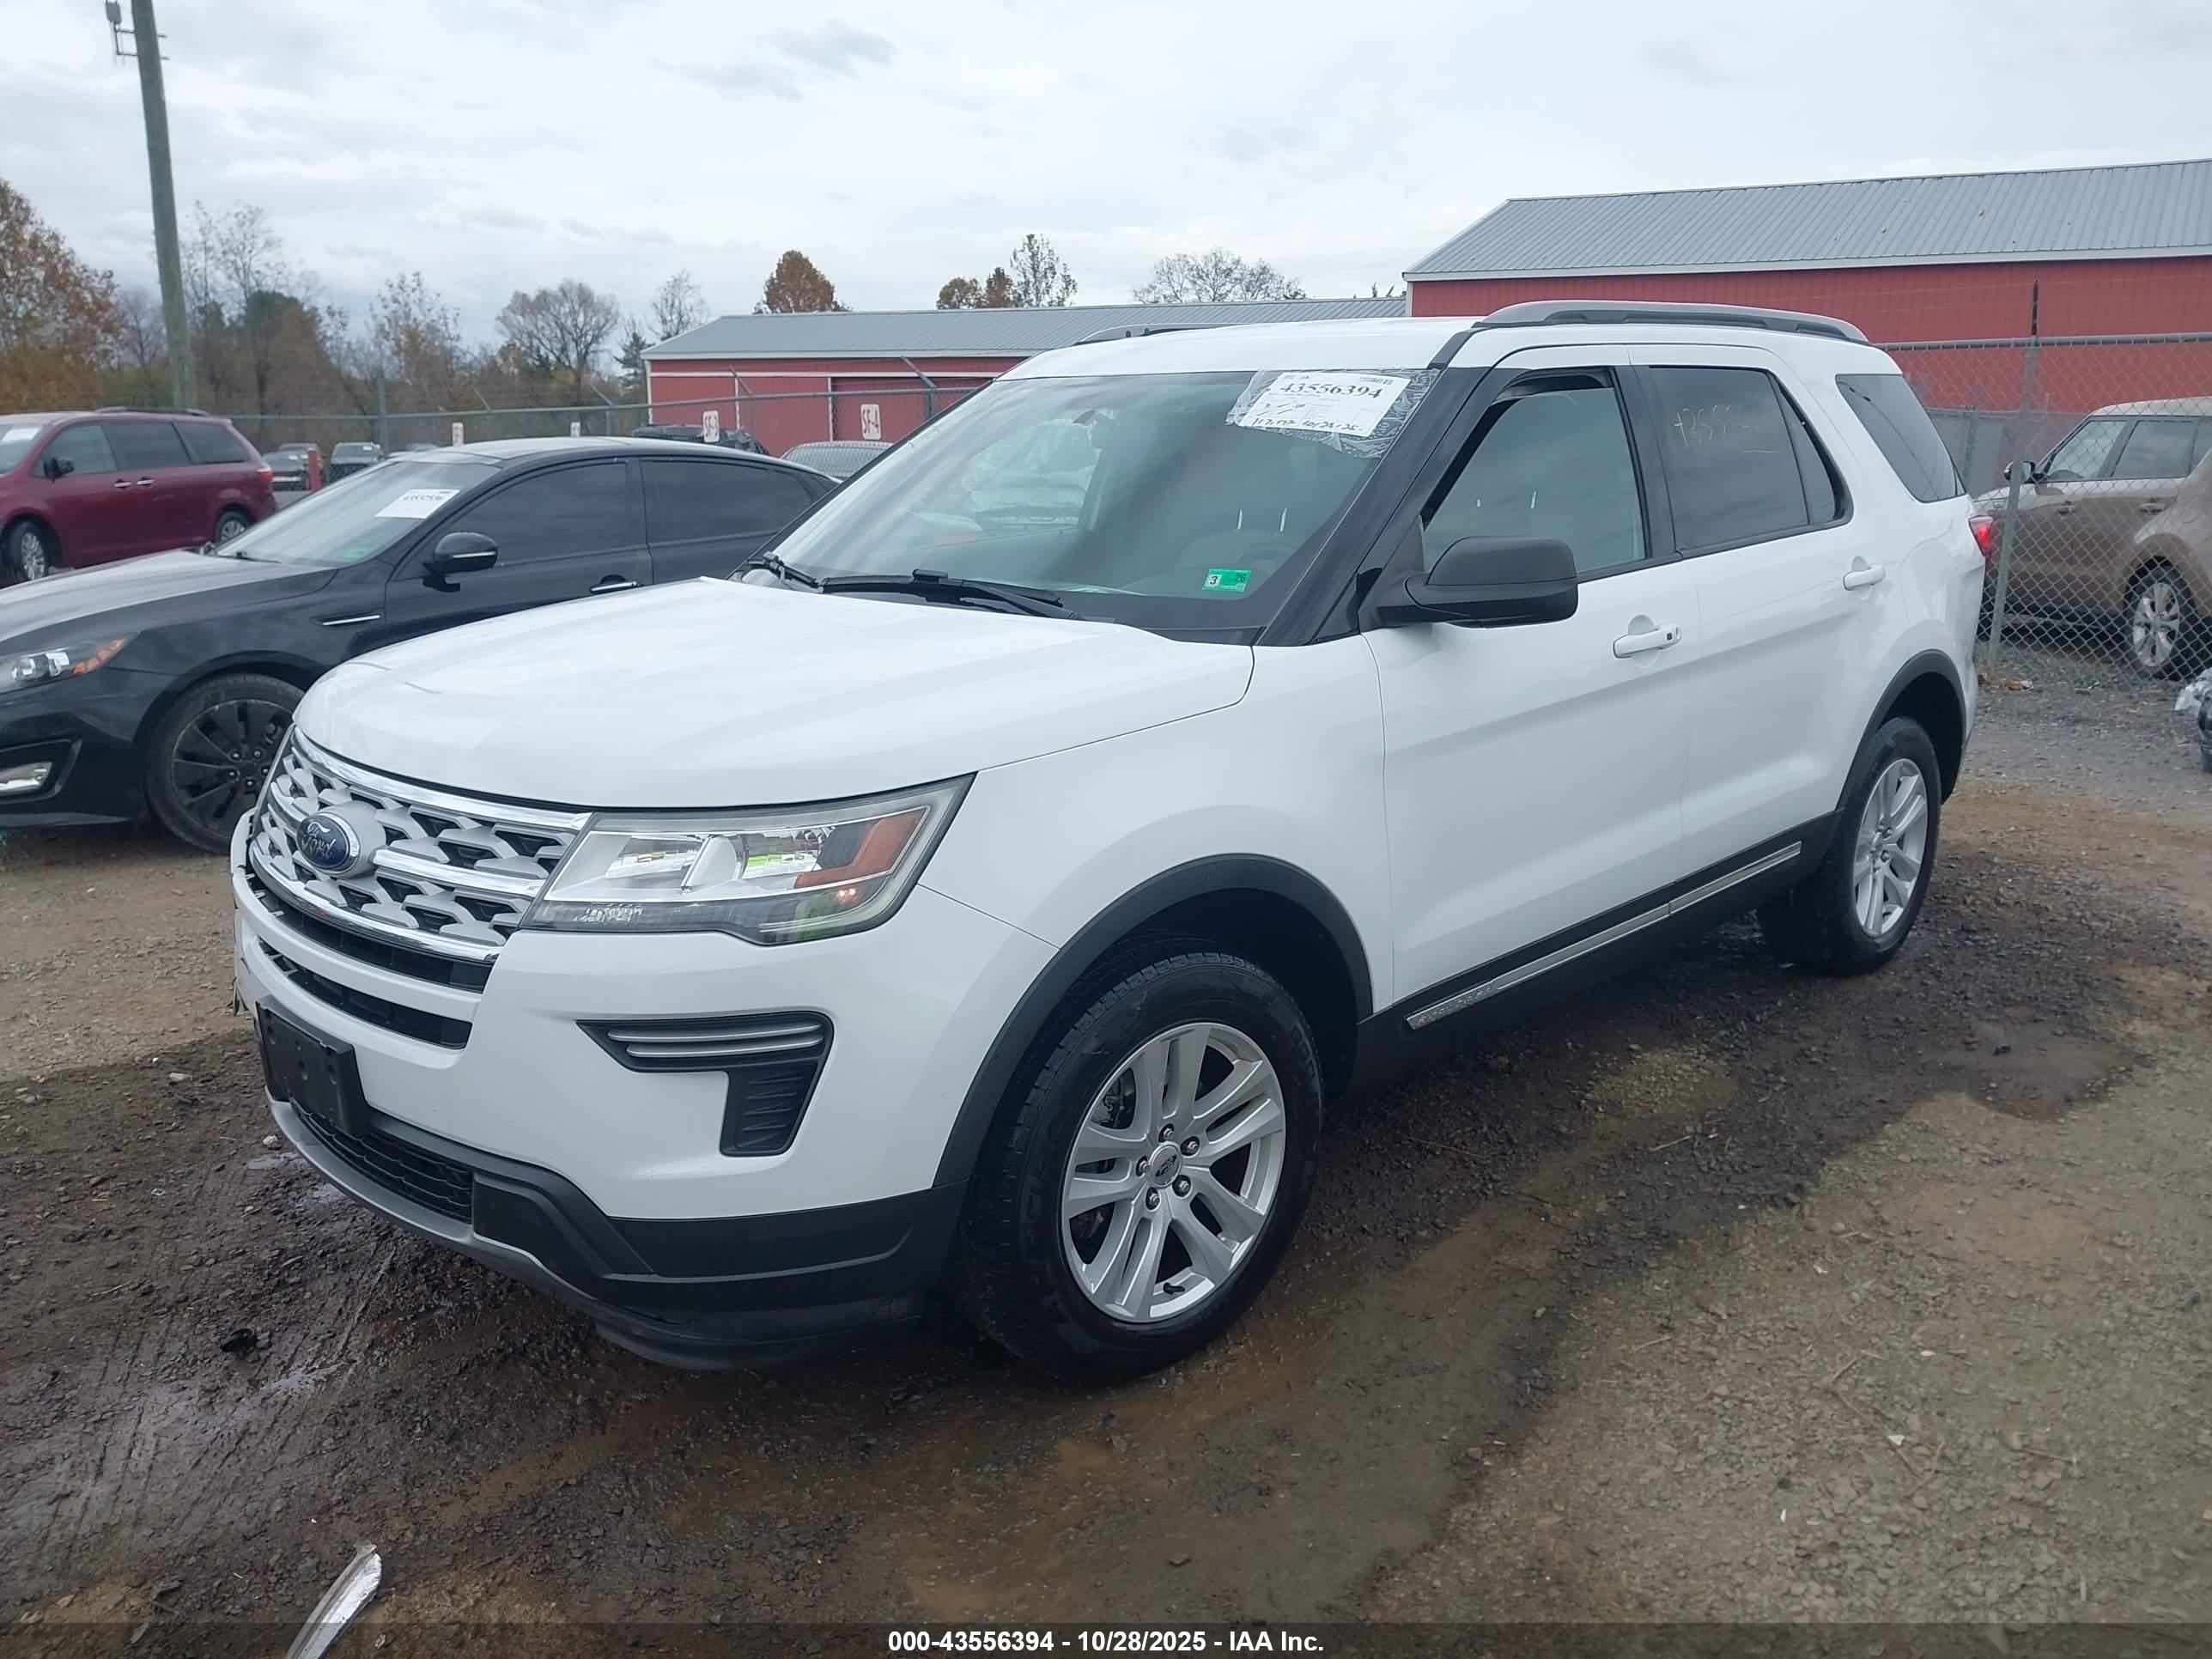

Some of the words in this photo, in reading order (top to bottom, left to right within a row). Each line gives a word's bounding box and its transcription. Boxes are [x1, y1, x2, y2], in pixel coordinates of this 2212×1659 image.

[1279, 383, 1383, 398] 43556394
[1209, 575, 1218, 586] 3
[301, 821, 337, 859] Ford
